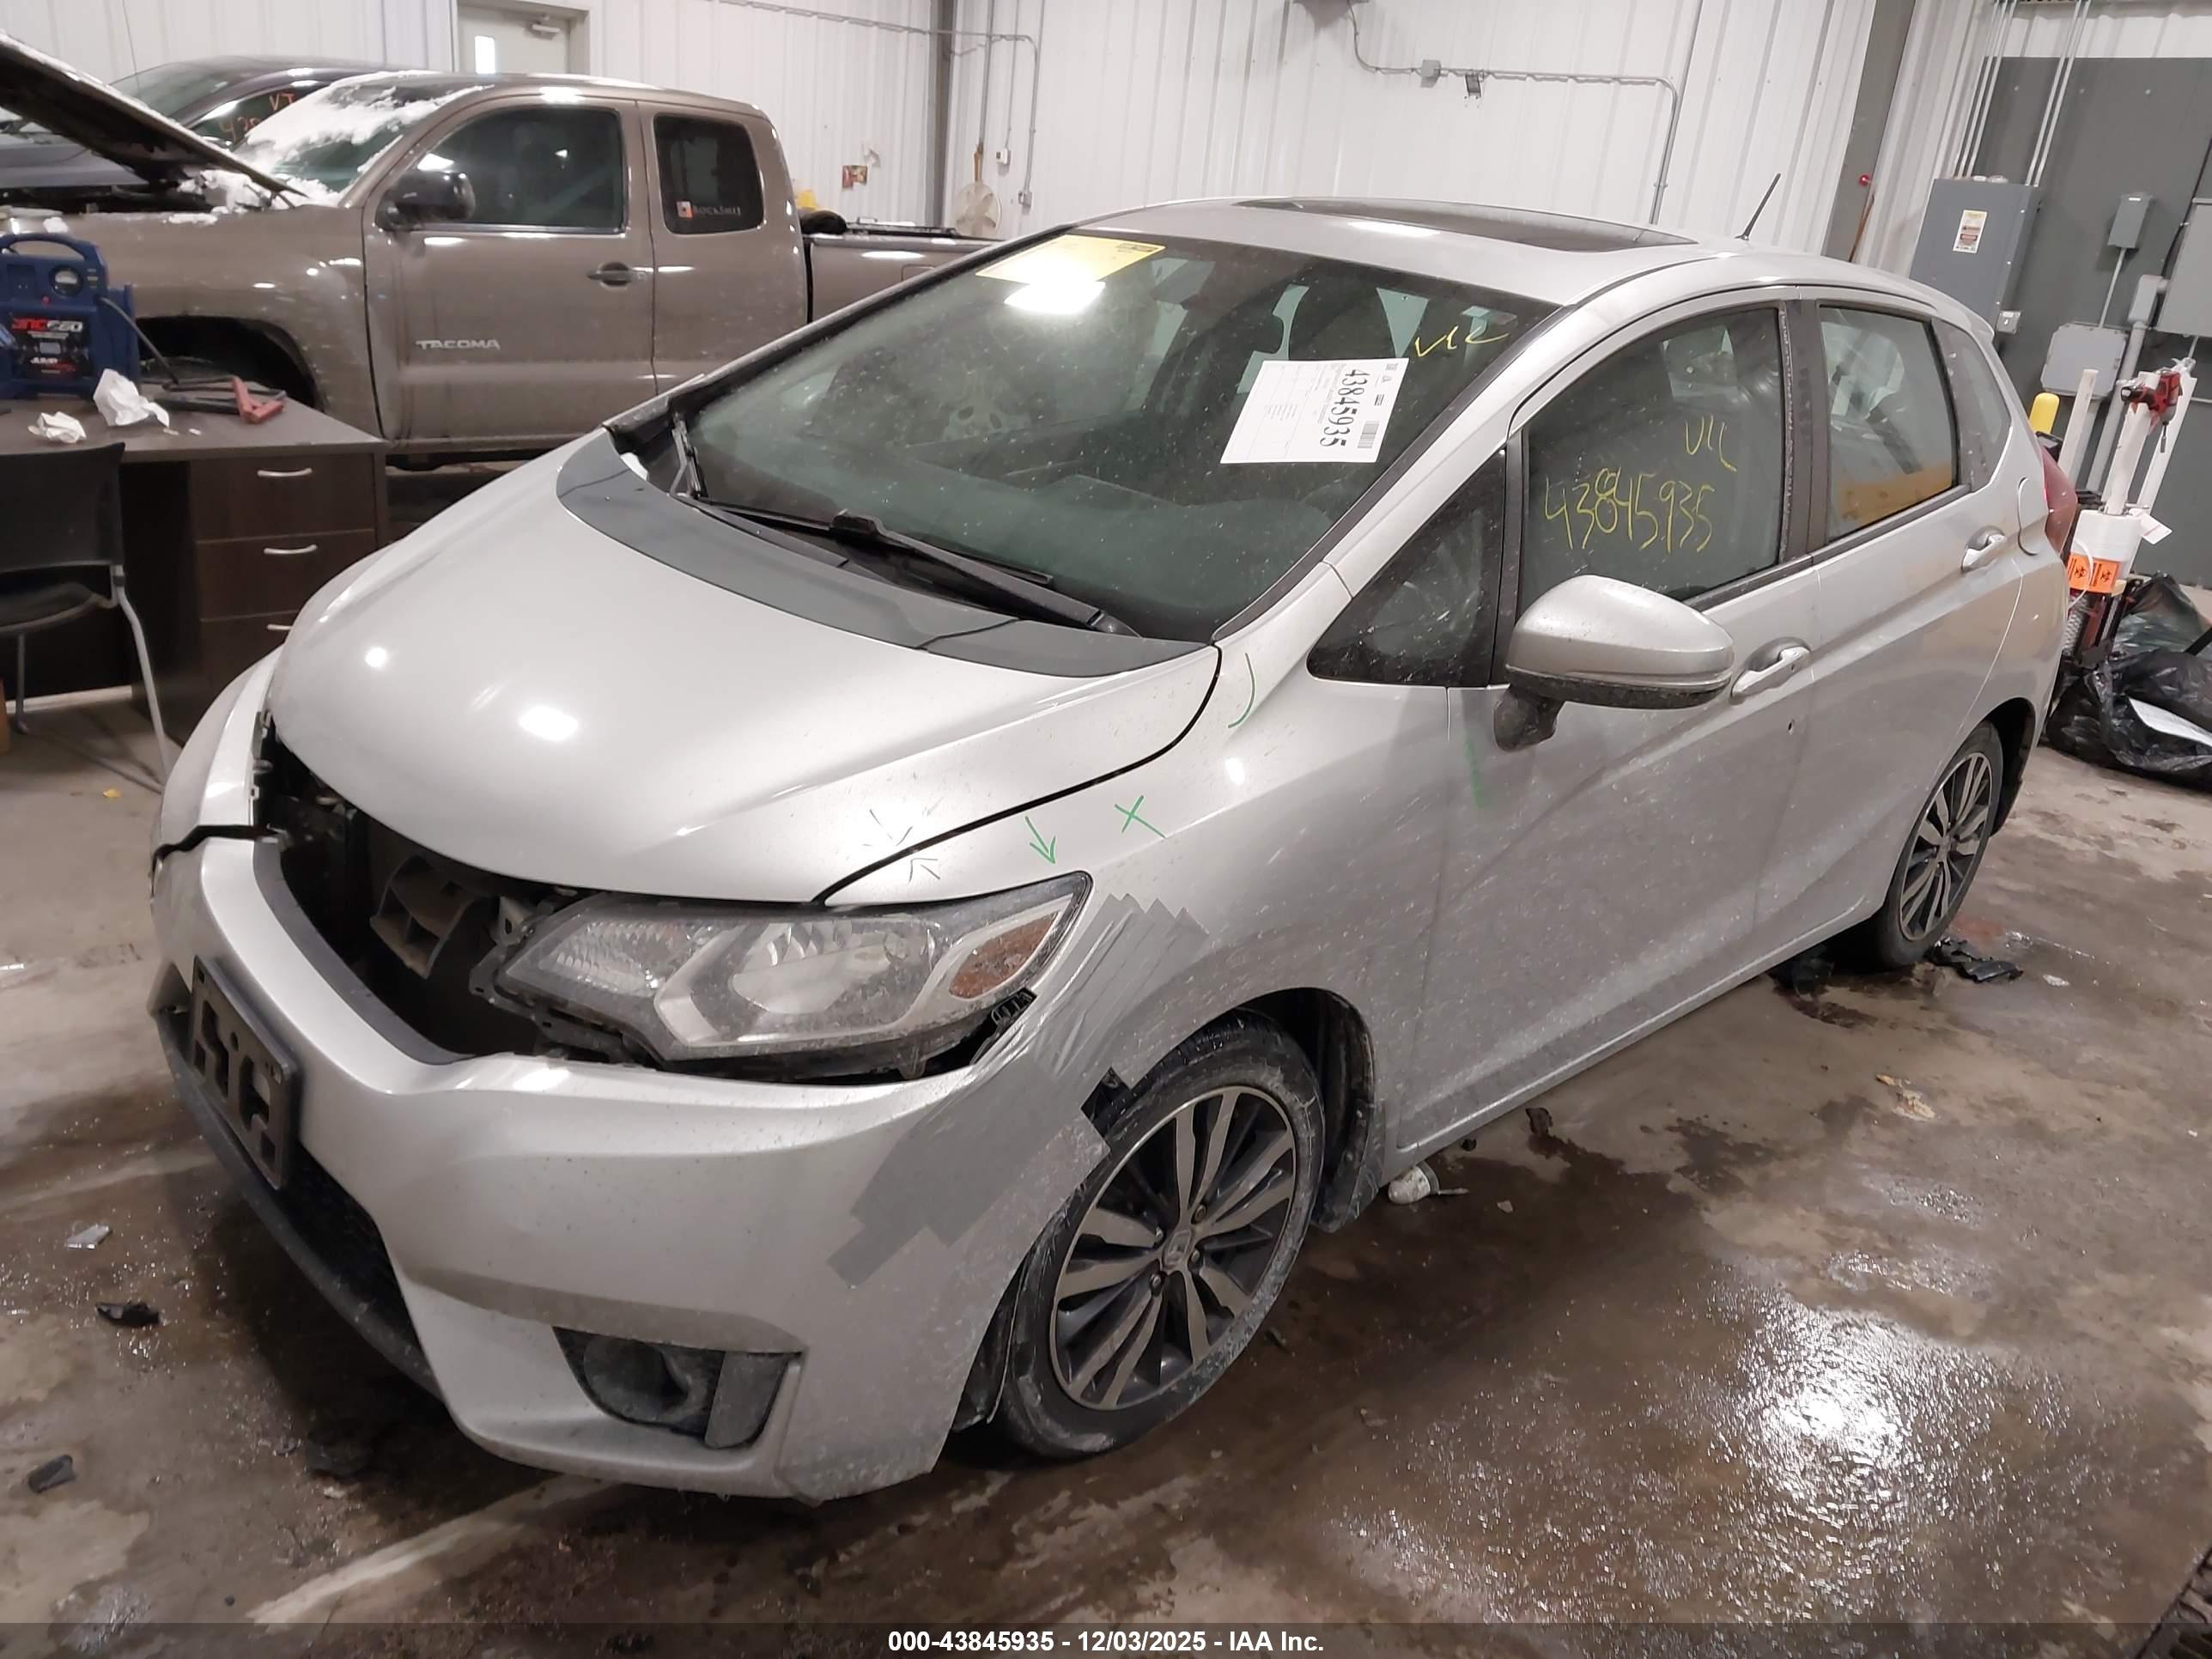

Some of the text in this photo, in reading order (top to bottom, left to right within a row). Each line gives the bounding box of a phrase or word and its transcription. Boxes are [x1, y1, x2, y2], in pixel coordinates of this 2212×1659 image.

[416, 340, 501, 350] TACOMA
[1319, 369, 1370, 447] 43845935
[1546, 467, 1715, 553] 43845935
